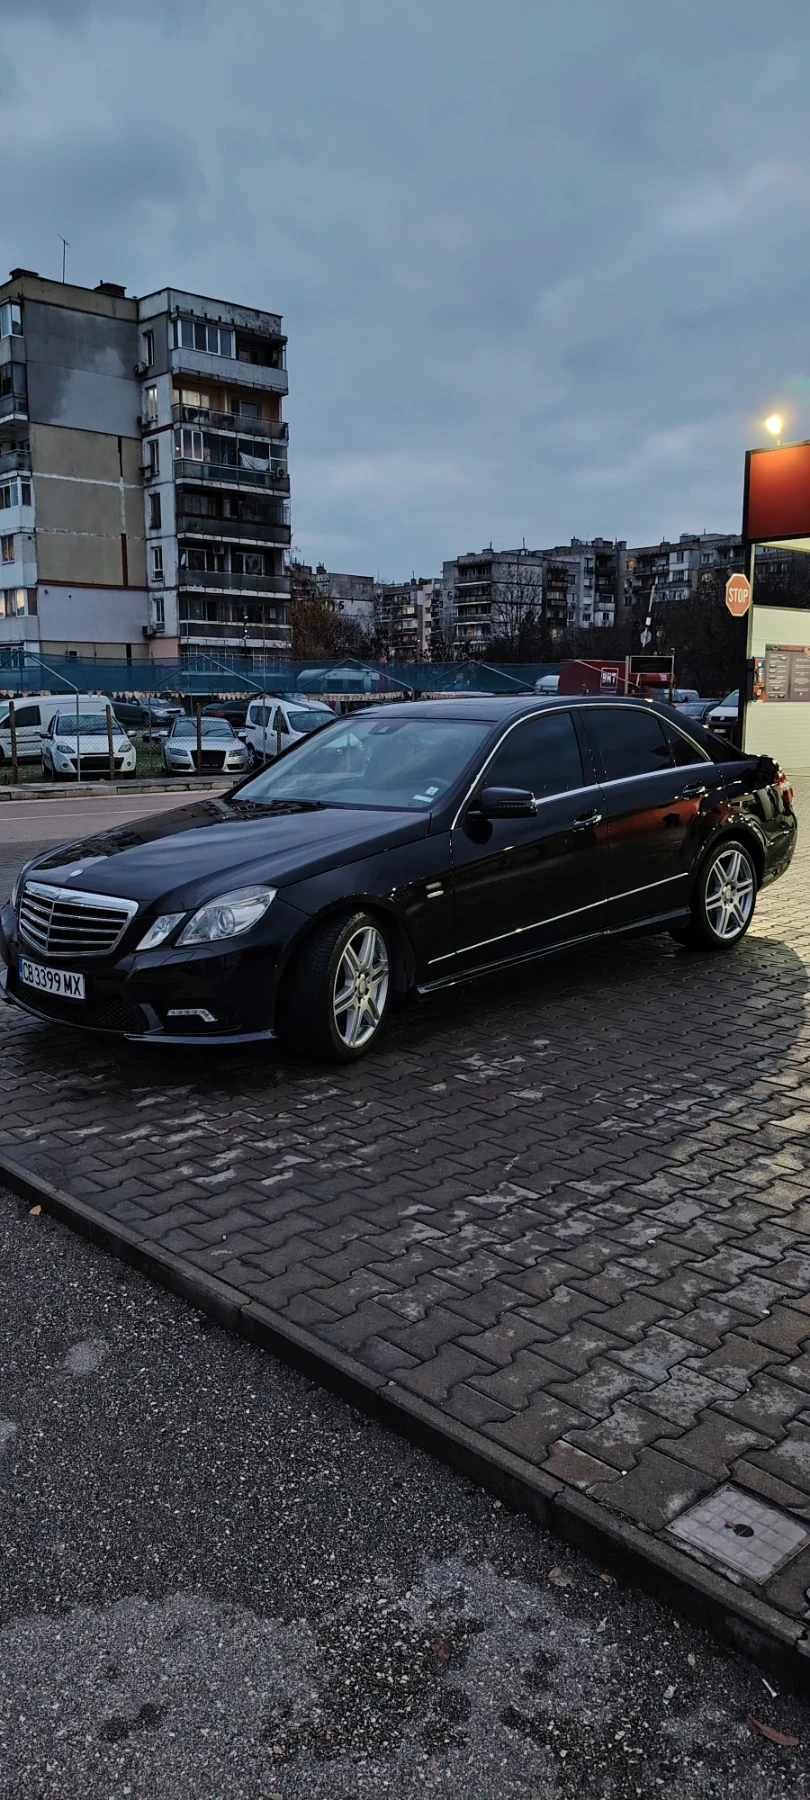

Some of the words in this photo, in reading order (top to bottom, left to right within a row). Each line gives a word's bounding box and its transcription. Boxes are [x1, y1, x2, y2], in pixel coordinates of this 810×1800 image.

[728, 587, 749, 603] STOP
[23, 961, 34, 983] CB
[34, 966, 61, 992] 3399
[63, 973, 82, 997] MX
